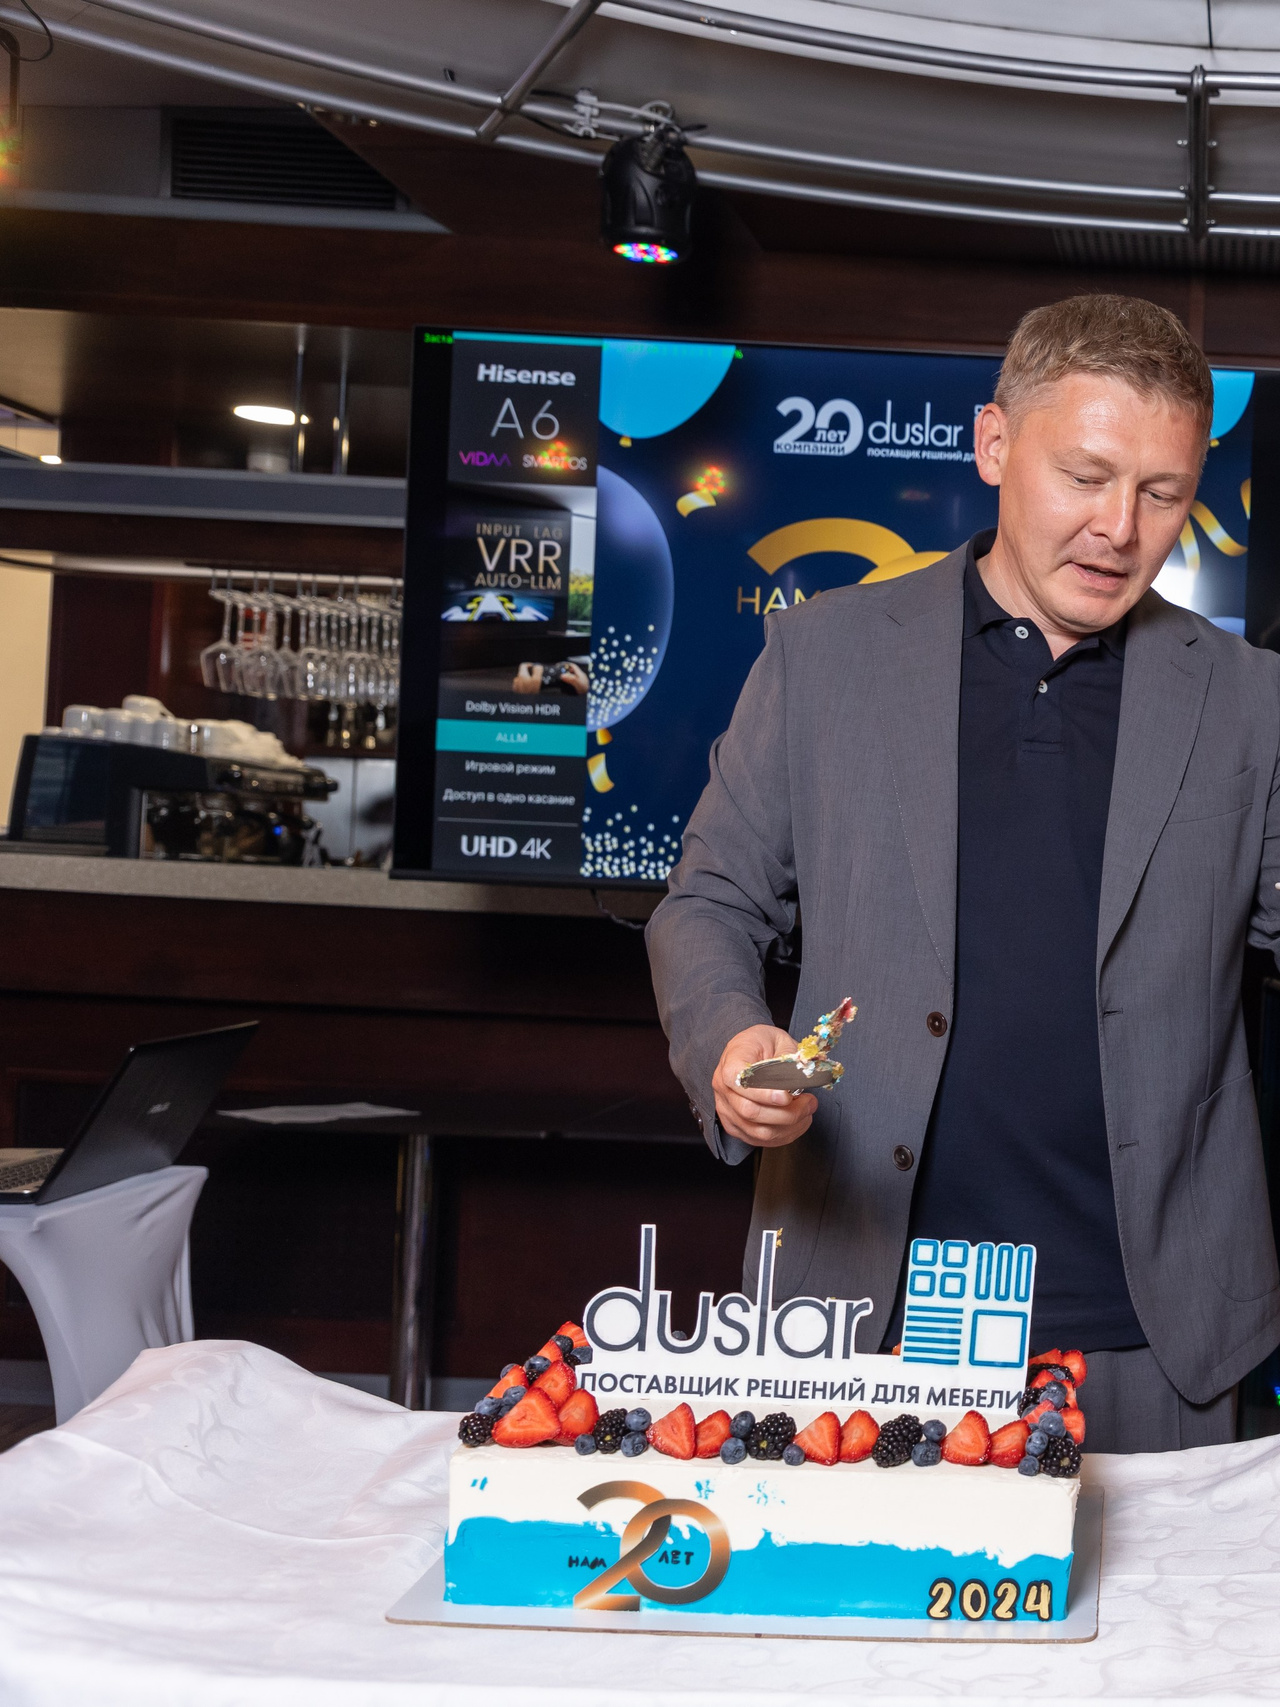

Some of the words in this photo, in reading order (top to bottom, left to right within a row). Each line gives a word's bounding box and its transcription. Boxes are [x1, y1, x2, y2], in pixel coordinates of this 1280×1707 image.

[477, 363, 576, 386] Hisense
[490, 397, 525, 439] A
[531, 400, 560, 440] 6
[773, 396, 864, 456] 20
[868, 400, 963, 447] duslar
[776, 442, 846, 454] компании
[814, 430, 848, 443] лет
[866, 447, 921, 460] ПОСТАВЩИК
[921, 450, 963, 461] РЕШЕНИЙ
[963, 452, 976, 463] ДЛ
[476, 523, 522, 537] INPUT
[533, 525, 564, 539] LAG
[477, 536, 563, 574] VRR
[474, 572, 562, 590] AUTO-LLM
[465, 700, 498, 715] Dolby
[498, 702, 534, 715] Vision
[534, 704, 561, 716] HDR
[465, 760, 515, 775] Игровой
[515, 764, 556, 776] режим
[442, 788, 486, 803] Доступ
[486, 792, 496, 802] в
[496, 793, 527, 805] одно
[527, 794, 576, 806] касание
[460, 835, 517, 857] UHD
[520, 837, 552, 859] 4K
[585, 1225, 872, 1360] duslar
[580, 1372, 740, 1397] ПОСТАВЩИК
[746, 1377, 866, 1402] РЕШЕНИЙ
[871, 1383, 920, 1404] ДЛЯ
[926, 1386, 1023, 1410] МЕБЕЛИ
[573, 1480, 732, 1612] 20
[927, 1577, 1053, 1622] 2024
